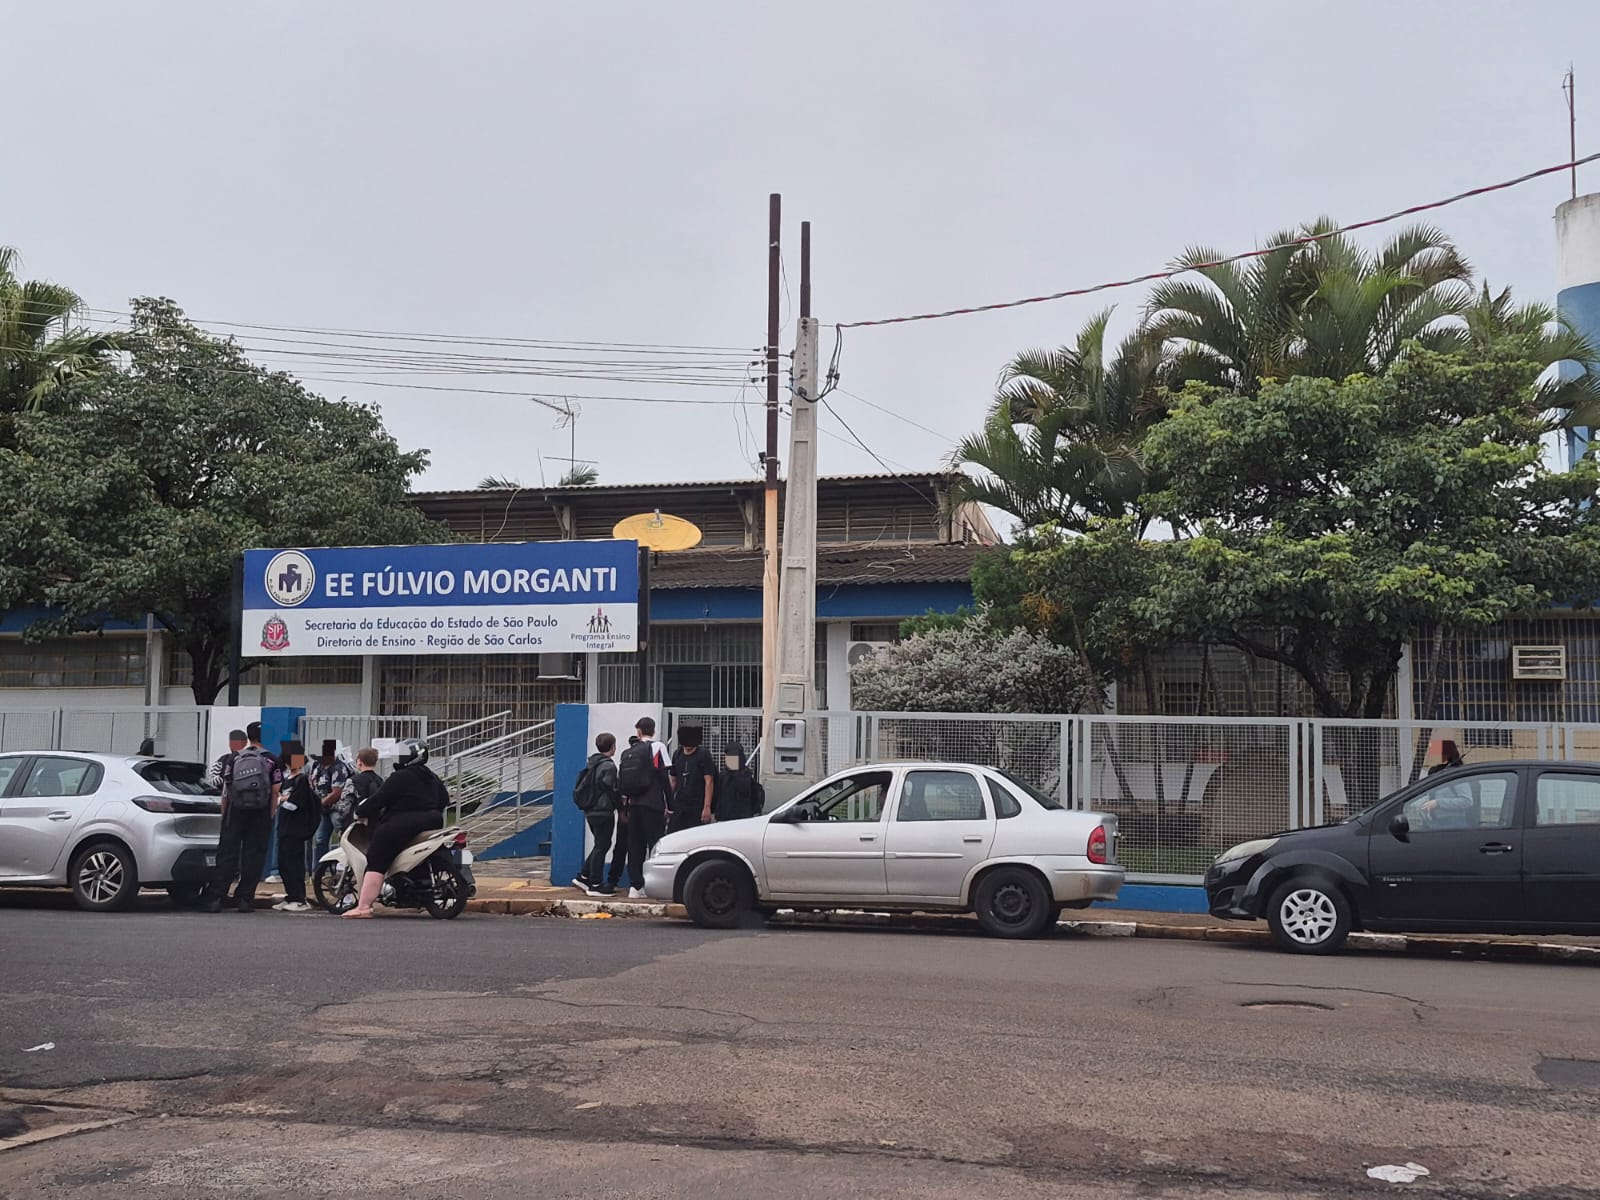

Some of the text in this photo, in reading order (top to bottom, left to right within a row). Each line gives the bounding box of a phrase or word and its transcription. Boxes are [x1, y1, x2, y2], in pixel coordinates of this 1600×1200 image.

[326, 573, 354, 597] EE
[362, 565, 455, 596] FÚLVIO
[463, 567, 617, 594] MORGANTI
[305, 614, 558, 631] Secretaria da Educação do Estado de São Paulo
[317, 635, 362, 648] Diretoria
[365, 634, 379, 647] de
[382, 634, 416, 647] Ensino
[427, 634, 464, 649] Região
[467, 633, 481, 646] de
[484, 634, 505, 646] São
[508, 633, 543, 646] Carlos
[571, 633, 605, 642] Programa
[587, 641, 614, 650] Integral
